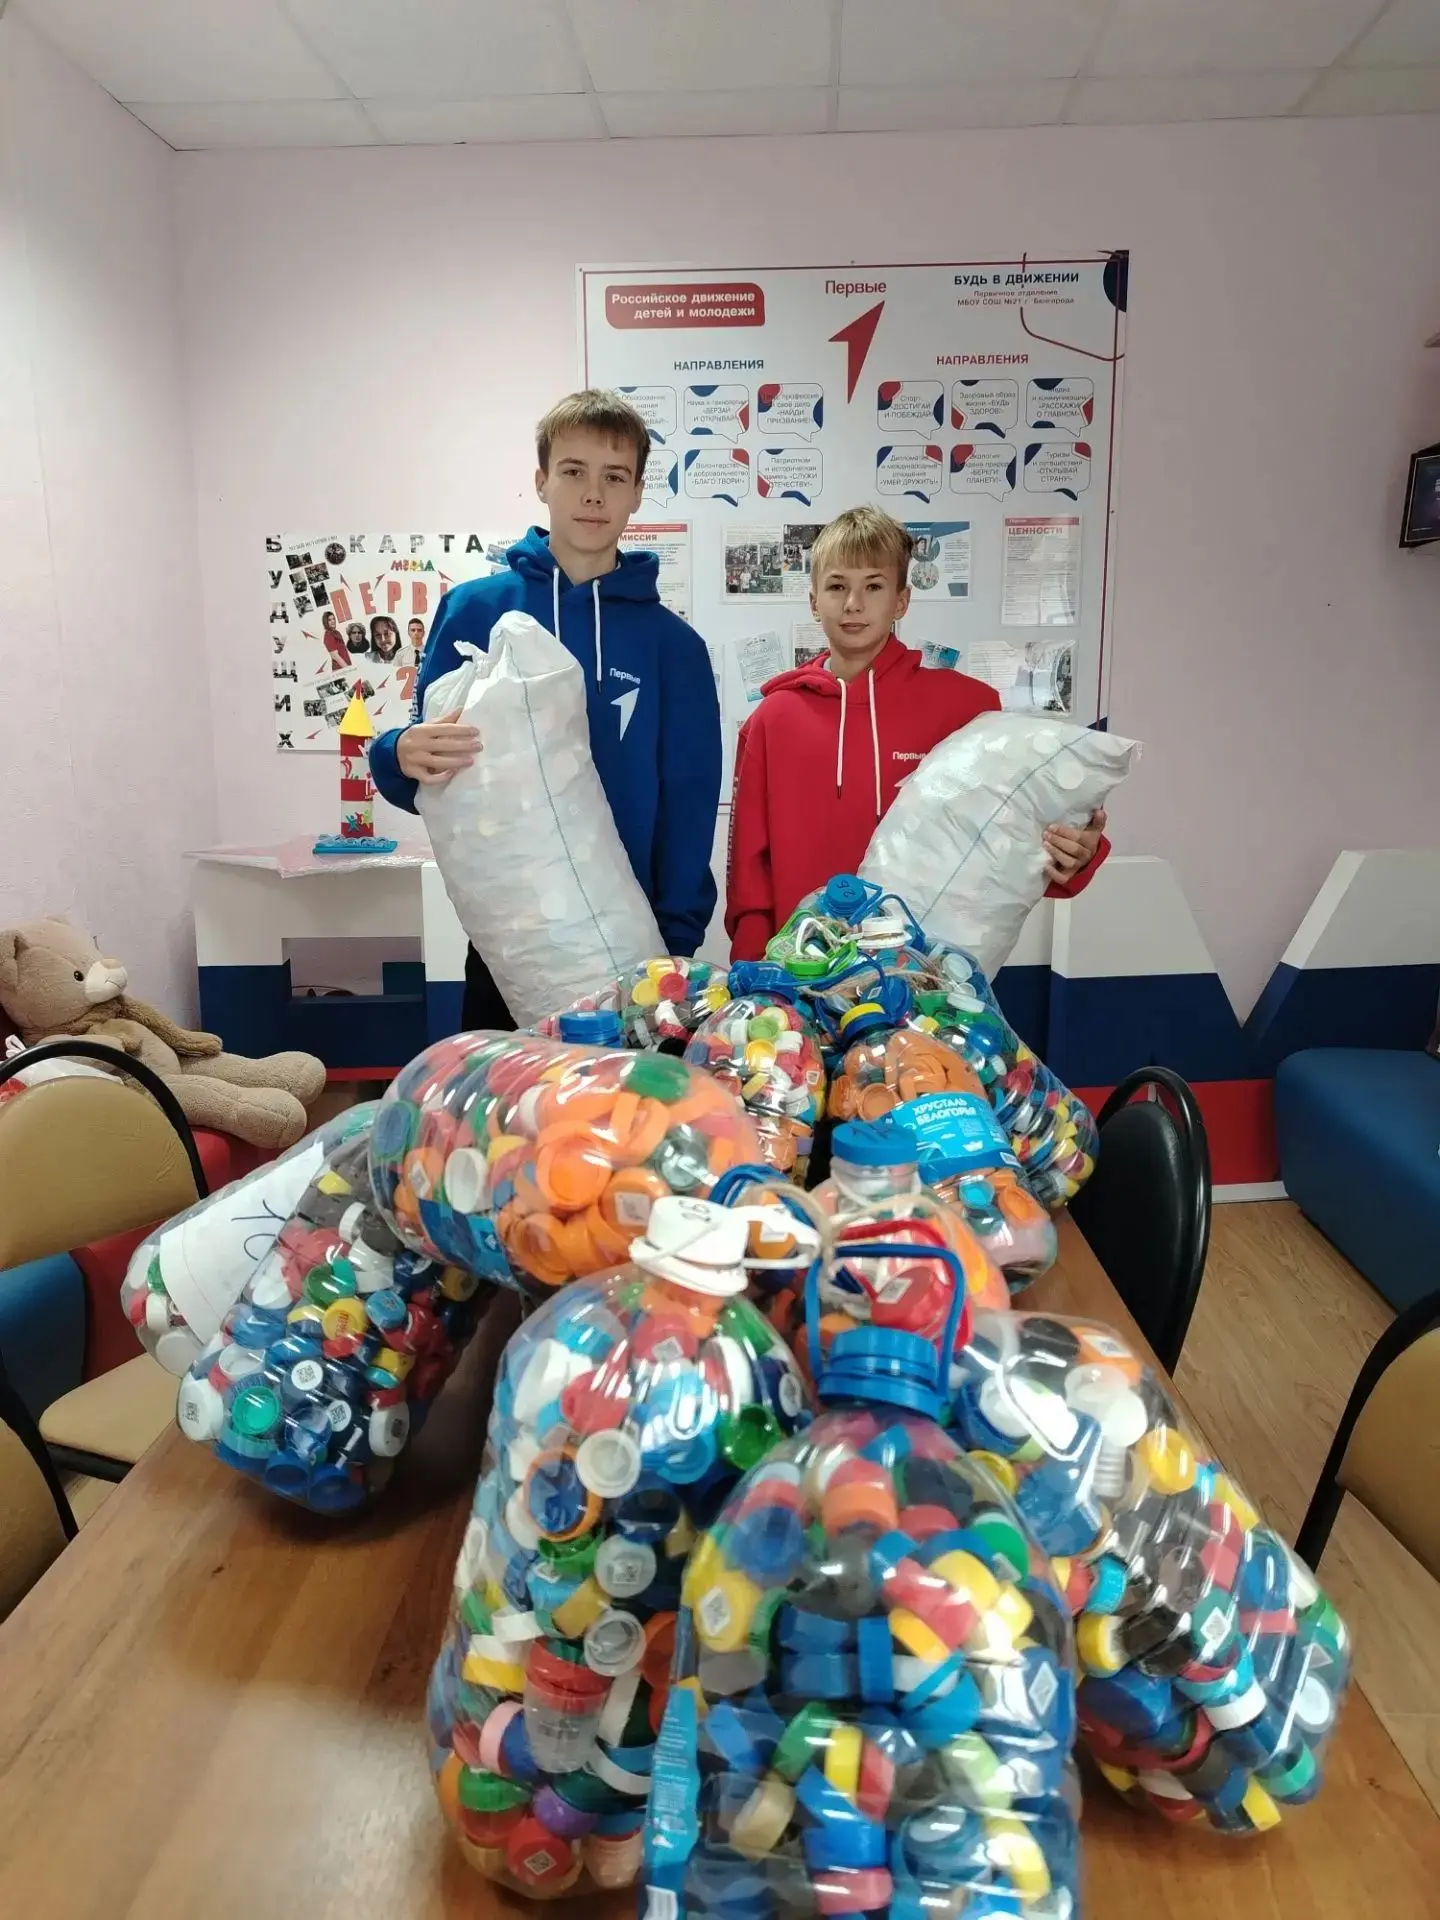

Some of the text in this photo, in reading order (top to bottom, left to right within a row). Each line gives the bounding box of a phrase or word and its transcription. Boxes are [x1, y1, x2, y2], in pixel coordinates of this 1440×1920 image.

[954, 272, 1079, 286] БУДЬ В ДВИЖЕНИИ
[825, 280, 887, 298] Первые
[612, 292, 755, 304] Российское движение
[634, 307, 672, 319] детей
[689, 307, 755, 319] молодежи
[674, 359, 764, 370] НАПРАВЛЕНИЯ
[936, 354, 1029, 365] НАПРАВЛЕНИЯ
[1008, 527, 1063, 536] ЦЕННОСТИ
[609, 667, 641, 685] Первые
[911, 1097, 968, 1116] ХРУСТАЛЬ
[915, 1106, 977, 1126] БЕЛОГОРЬЯ
